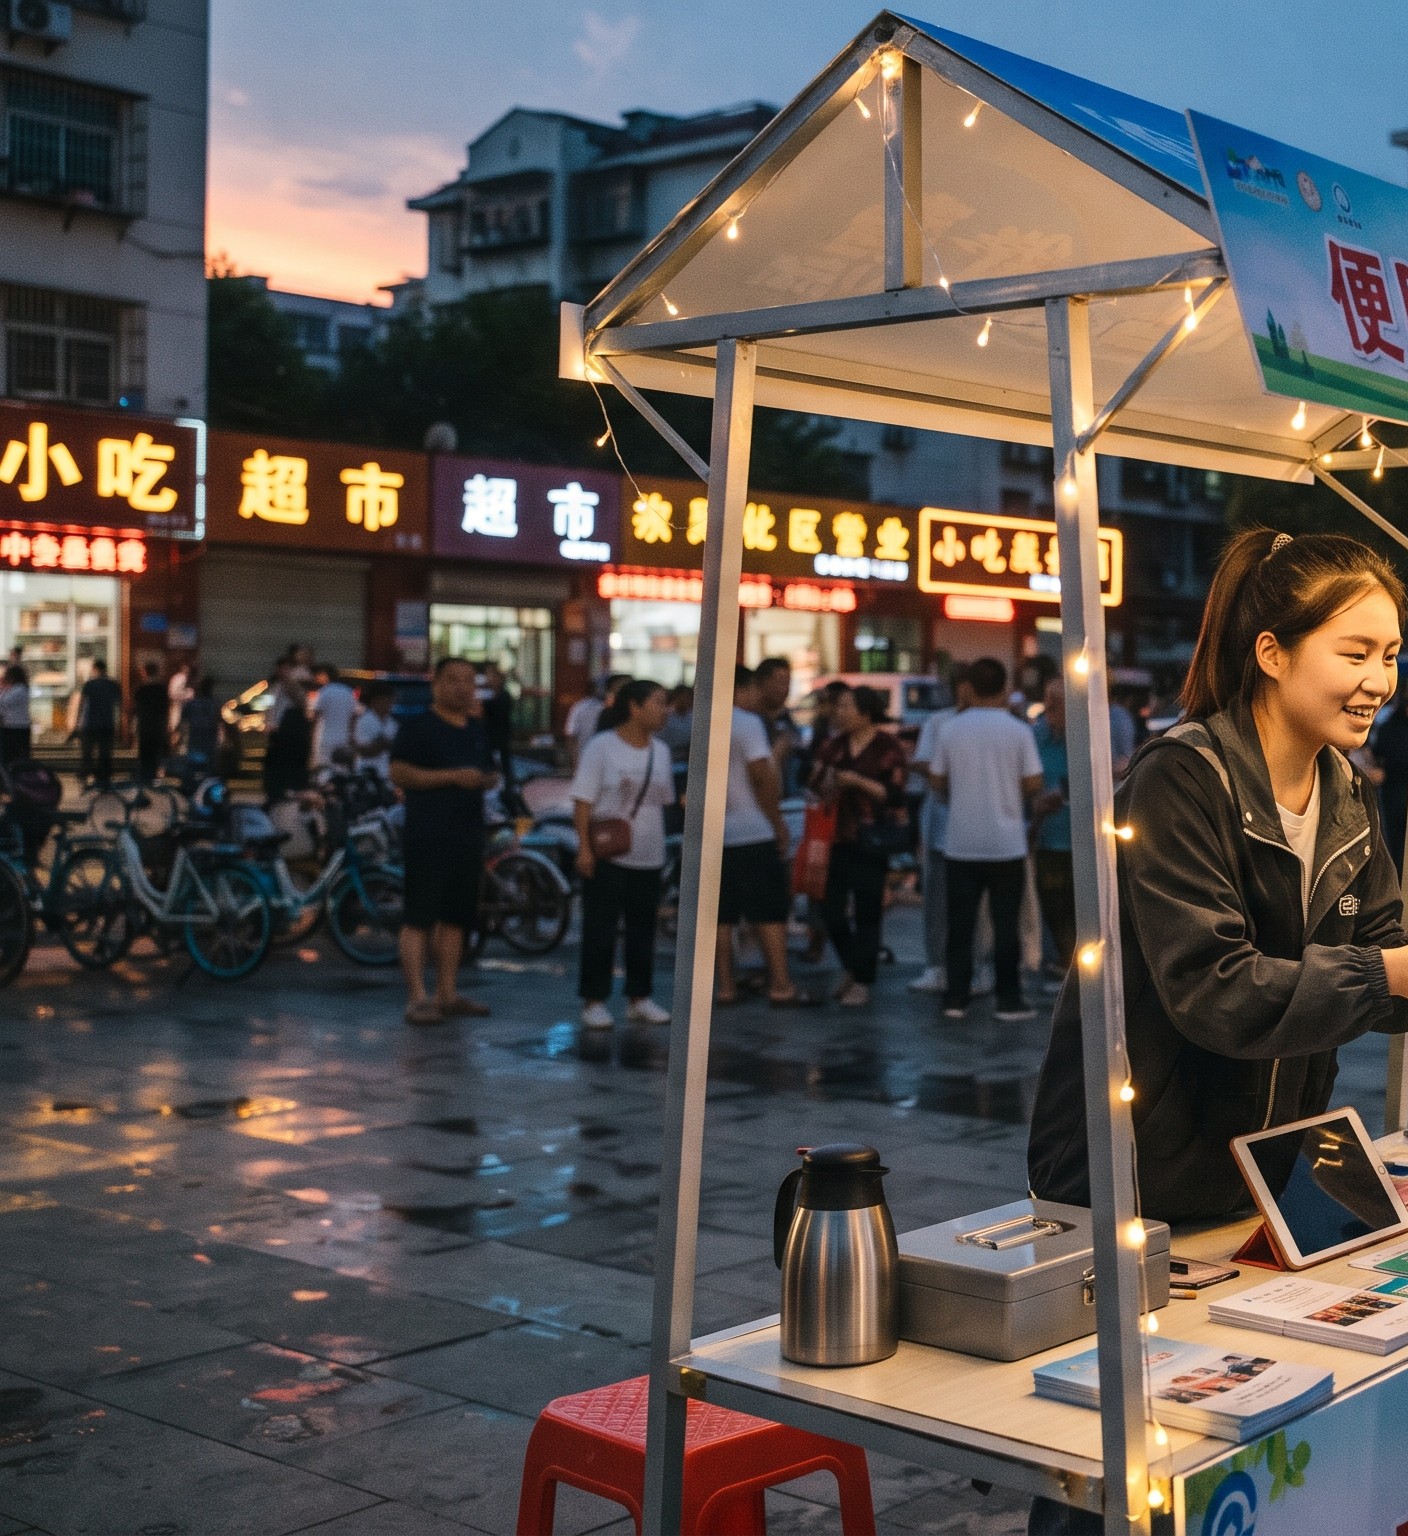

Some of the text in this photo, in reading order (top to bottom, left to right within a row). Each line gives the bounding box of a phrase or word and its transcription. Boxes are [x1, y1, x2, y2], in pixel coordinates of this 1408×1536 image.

[0, 422, 178, 512] 小吃
[238, 449, 404, 532] 超市
[461, 474, 600, 540] 超市
